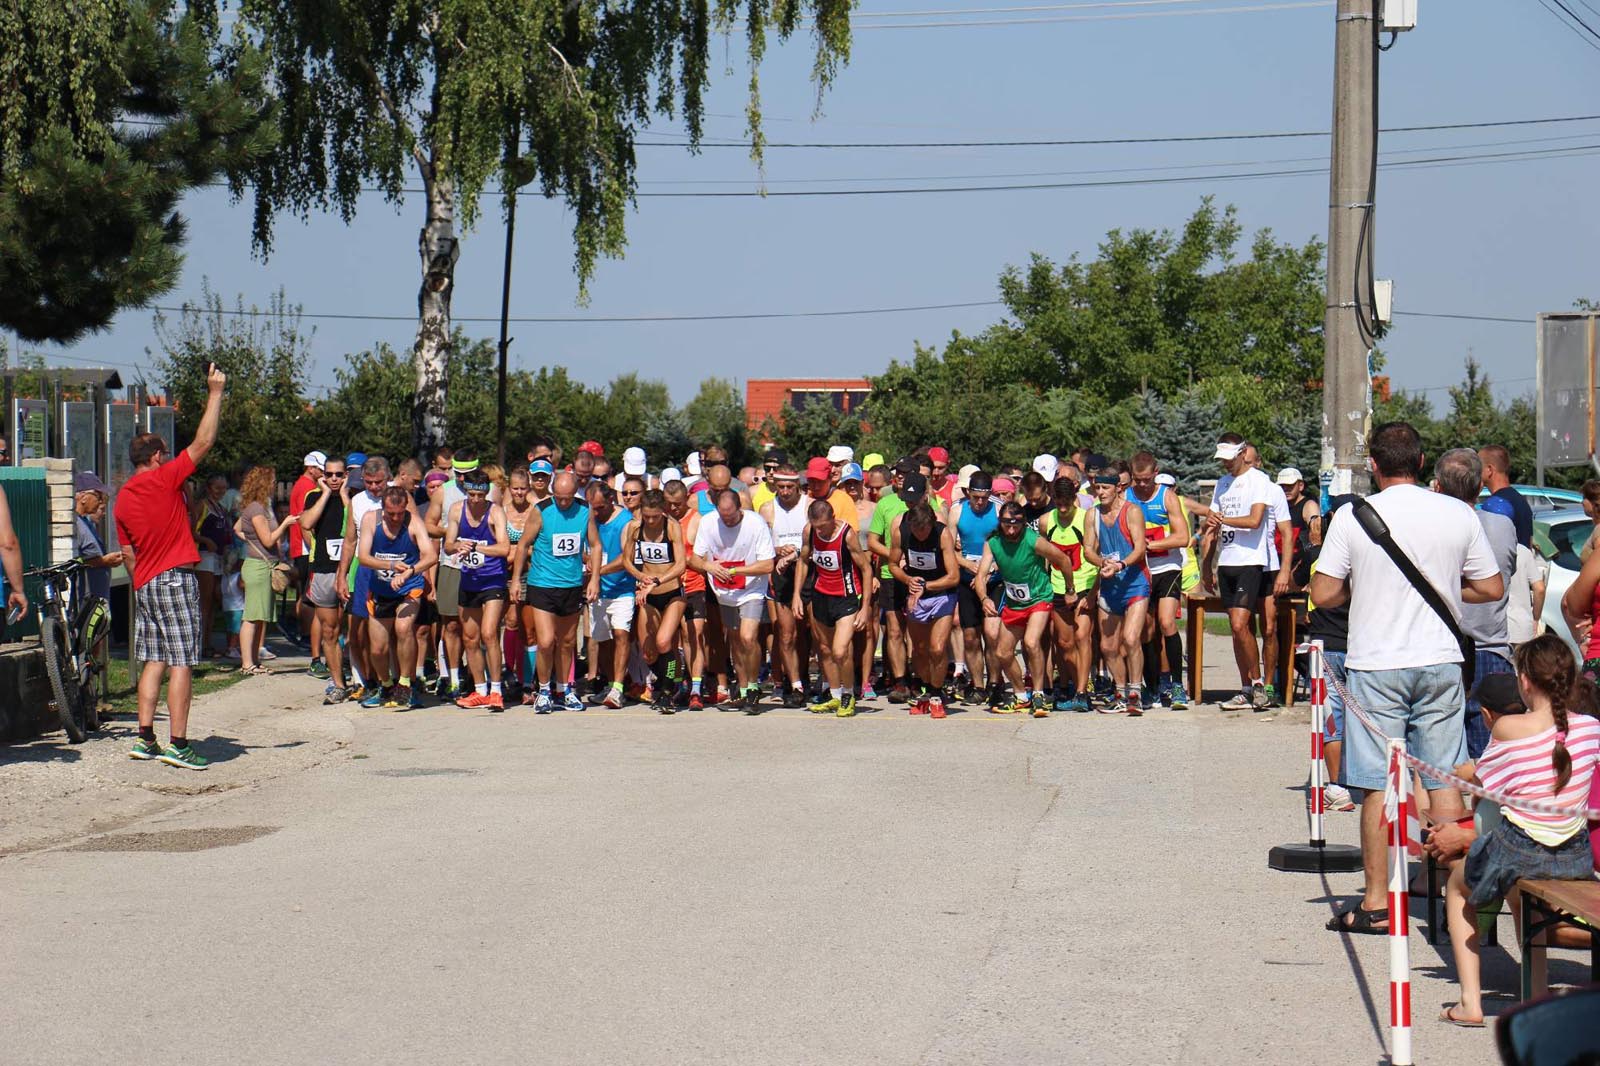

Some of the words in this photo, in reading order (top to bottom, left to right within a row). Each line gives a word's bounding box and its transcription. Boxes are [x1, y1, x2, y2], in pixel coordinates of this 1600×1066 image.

[1221, 530, 1235, 544] 59
[332, 544, 340, 556] 7
[557, 538, 575, 551] 43
[645, 547, 663, 560] 18
[816, 556, 833, 568] 48
[916, 556, 925, 567] 5
[1010, 587, 1026, 599] 10
